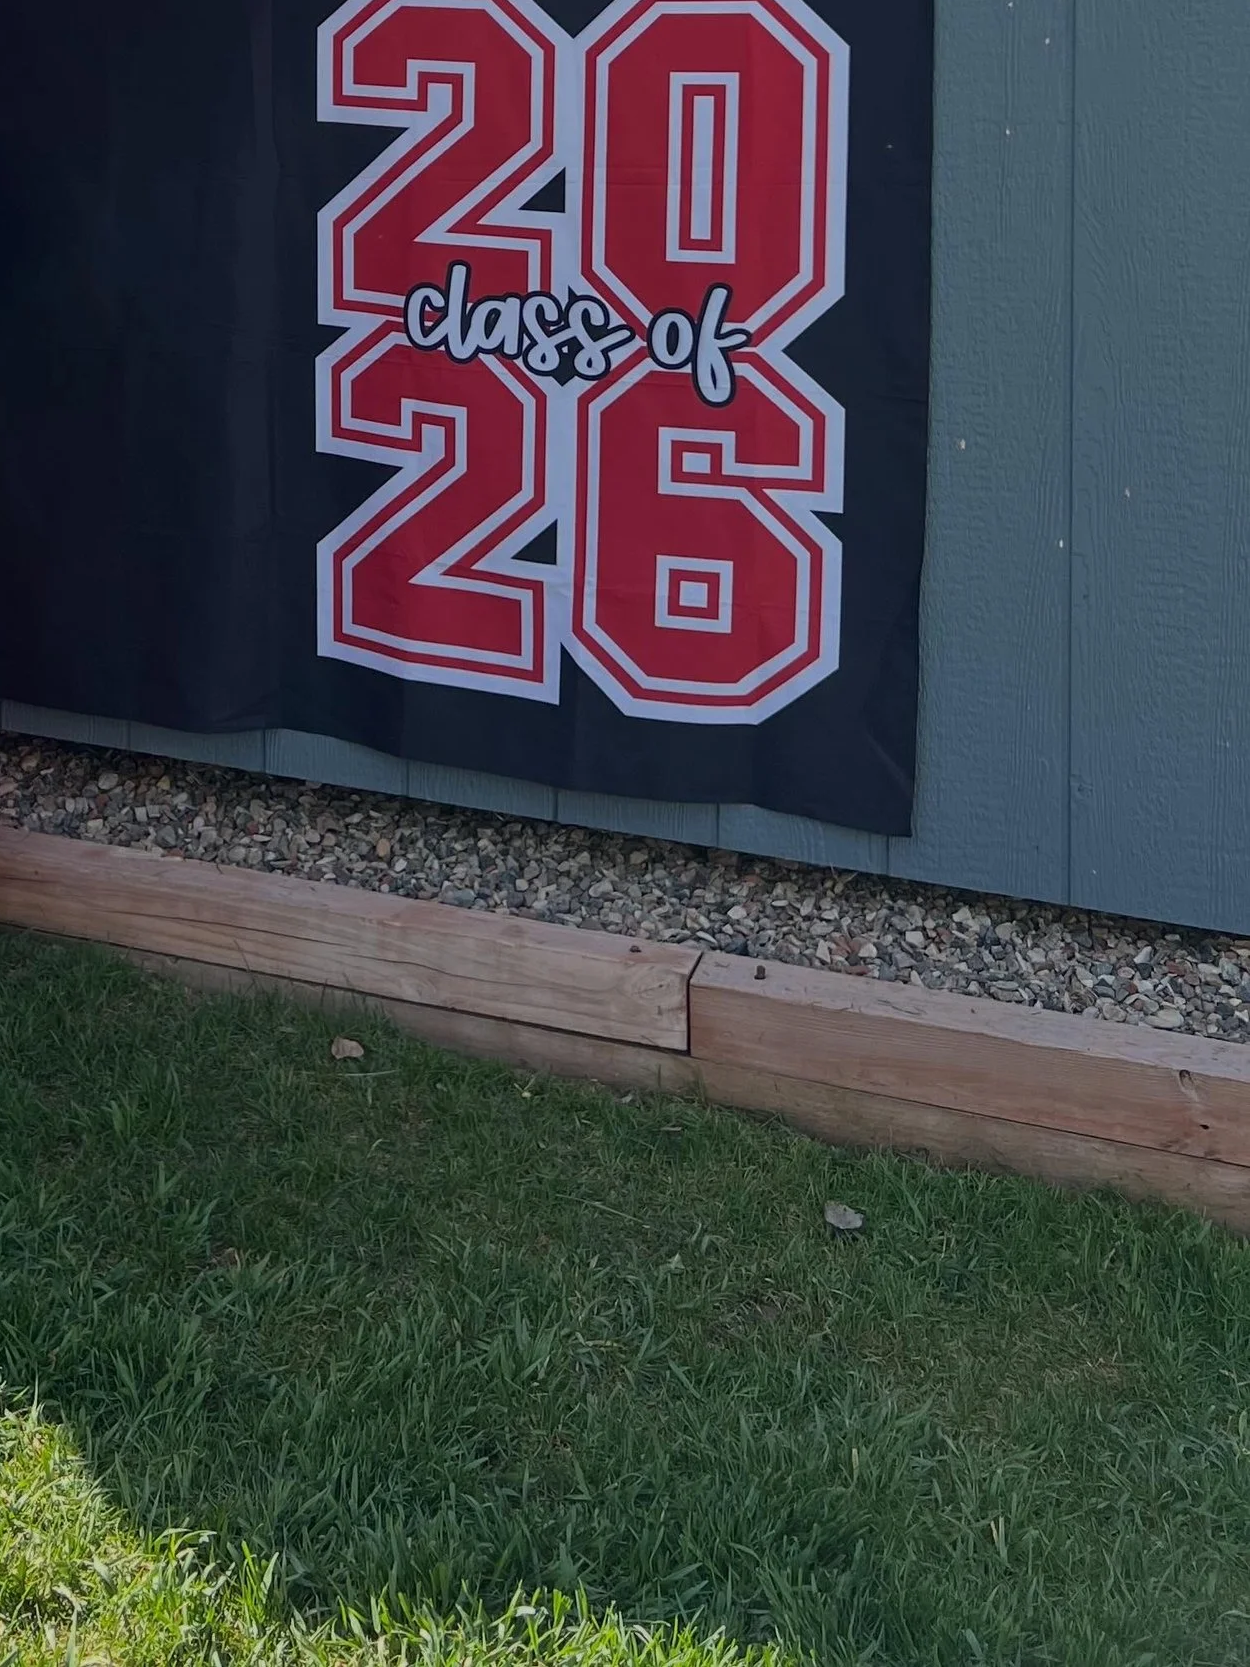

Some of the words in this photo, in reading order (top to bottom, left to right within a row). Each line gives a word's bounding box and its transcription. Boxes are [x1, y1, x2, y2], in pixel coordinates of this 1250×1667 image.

[402, 261, 635, 381] class
[646, 284, 750, 408] of
[316, 319, 846, 726] 26
